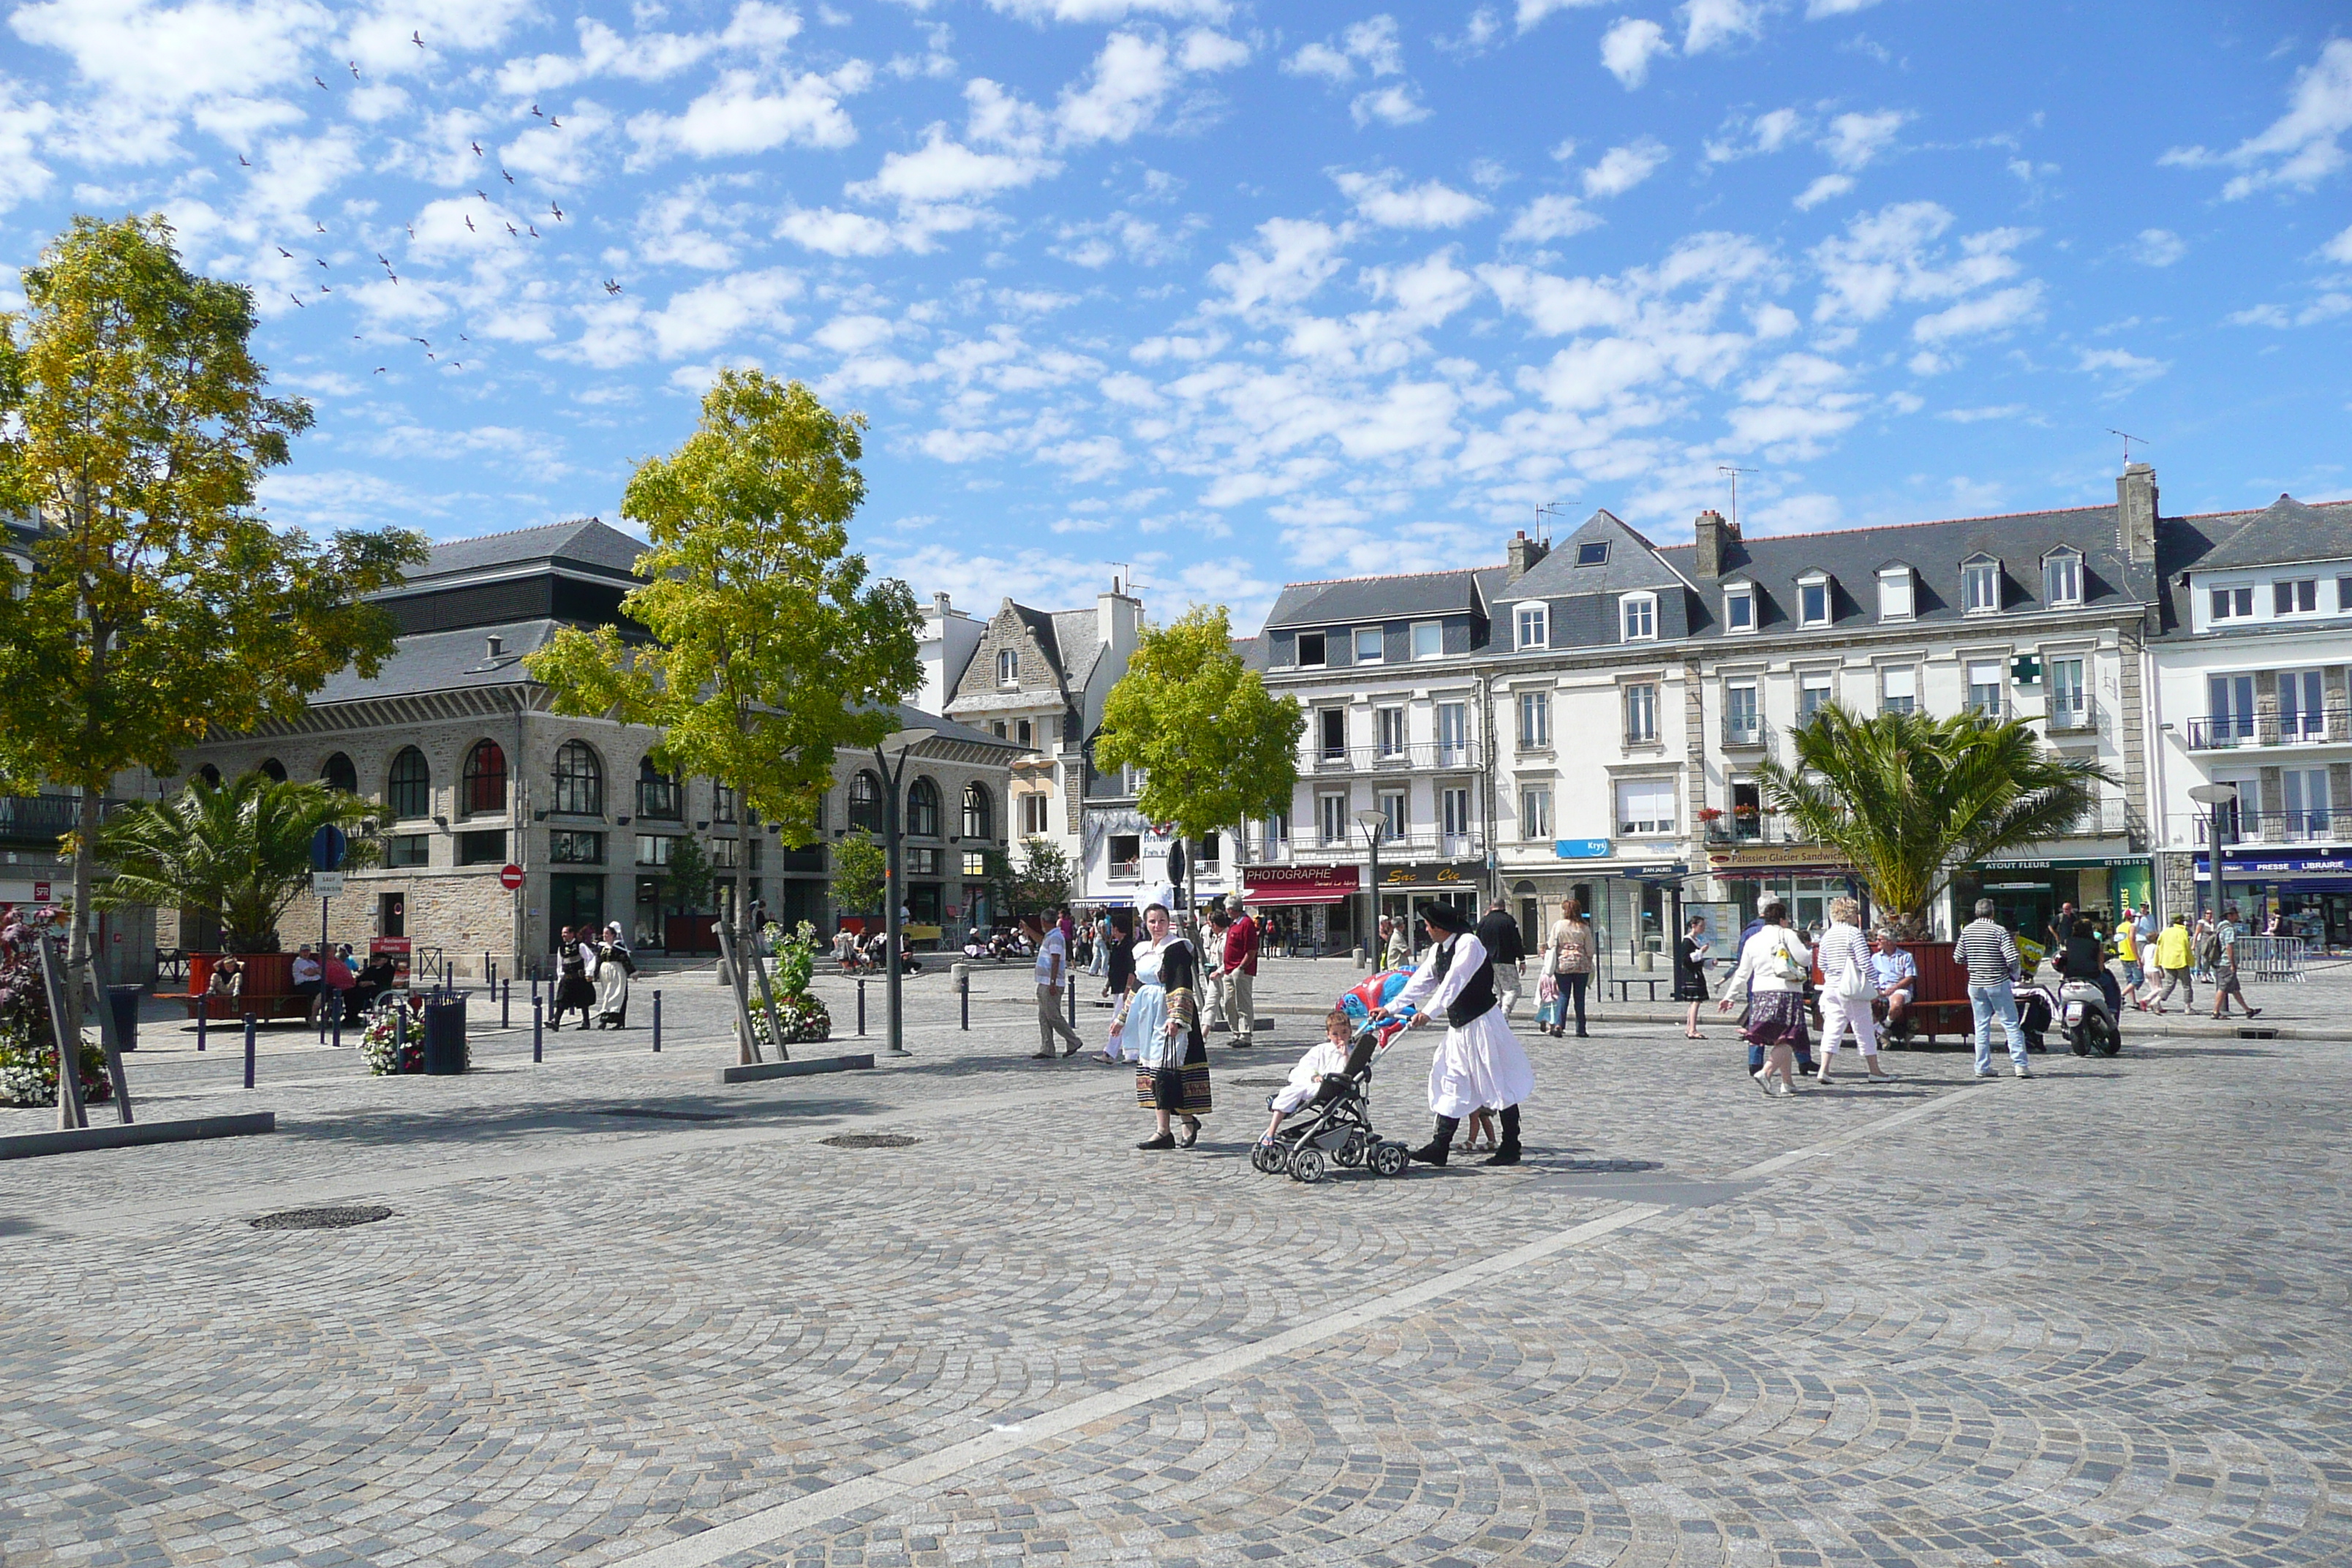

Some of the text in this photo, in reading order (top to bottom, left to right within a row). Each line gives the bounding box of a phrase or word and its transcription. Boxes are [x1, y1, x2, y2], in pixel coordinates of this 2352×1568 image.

[1588, 842, 1605, 851] Krys
[1769, 853, 1798, 862] Glacier
[2256, 861, 2345, 871] PRESSE LIBRAIRIE
[1246, 868, 1332, 881] PHOTOGRAPHE
[1387, 868, 1460, 882] Sac Cie
[36, 886, 49, 897] SFR
